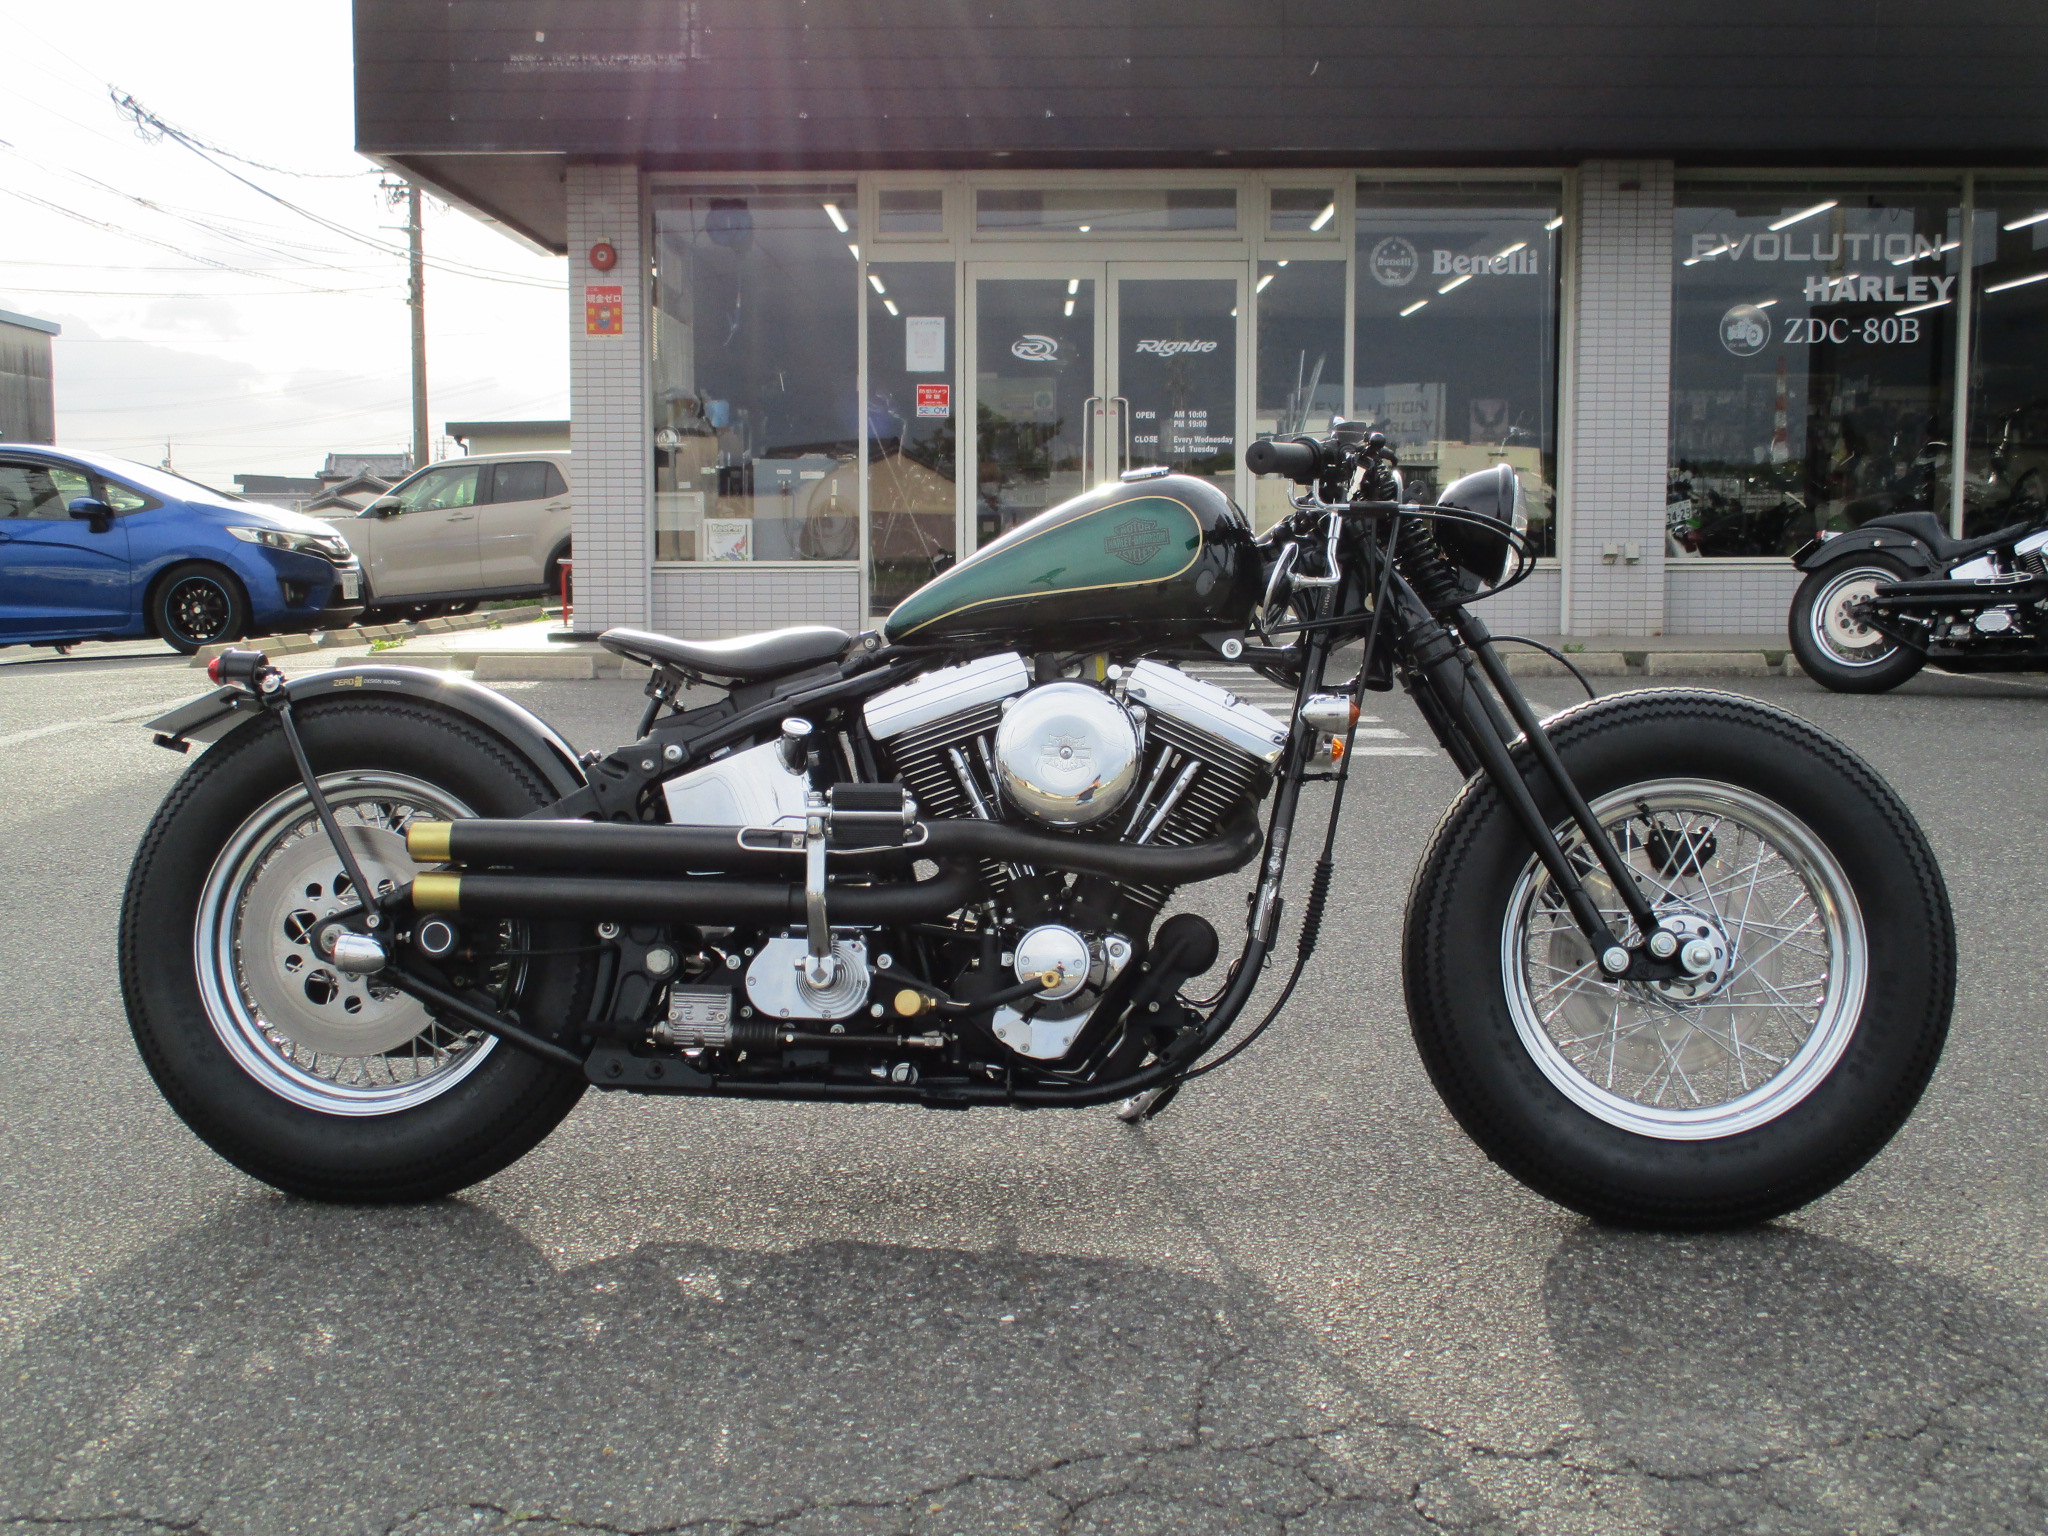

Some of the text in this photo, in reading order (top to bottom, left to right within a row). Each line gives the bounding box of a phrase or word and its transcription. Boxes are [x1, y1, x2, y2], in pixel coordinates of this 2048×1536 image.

[1691, 233, 1942, 262] EVOLUTION
[1377, 257, 1411, 267] Benelli
[1432, 249, 1538, 275] Benelli
[1805, 275, 1956, 302] HARLEY
[1783, 317, 1920, 345] ZDC-80B
[918, 407, 947, 415] SECOM
[1135, 411, 1208, 420] OPEN AM 10:00
[1174, 420, 1208, 428] PM 19:00
[1134, 435, 1234, 445] CLOSE Every Wednesday
[1174, 445, 1218, 454] 3rd Tuesday
[333, 678, 354, 687] ZERO
